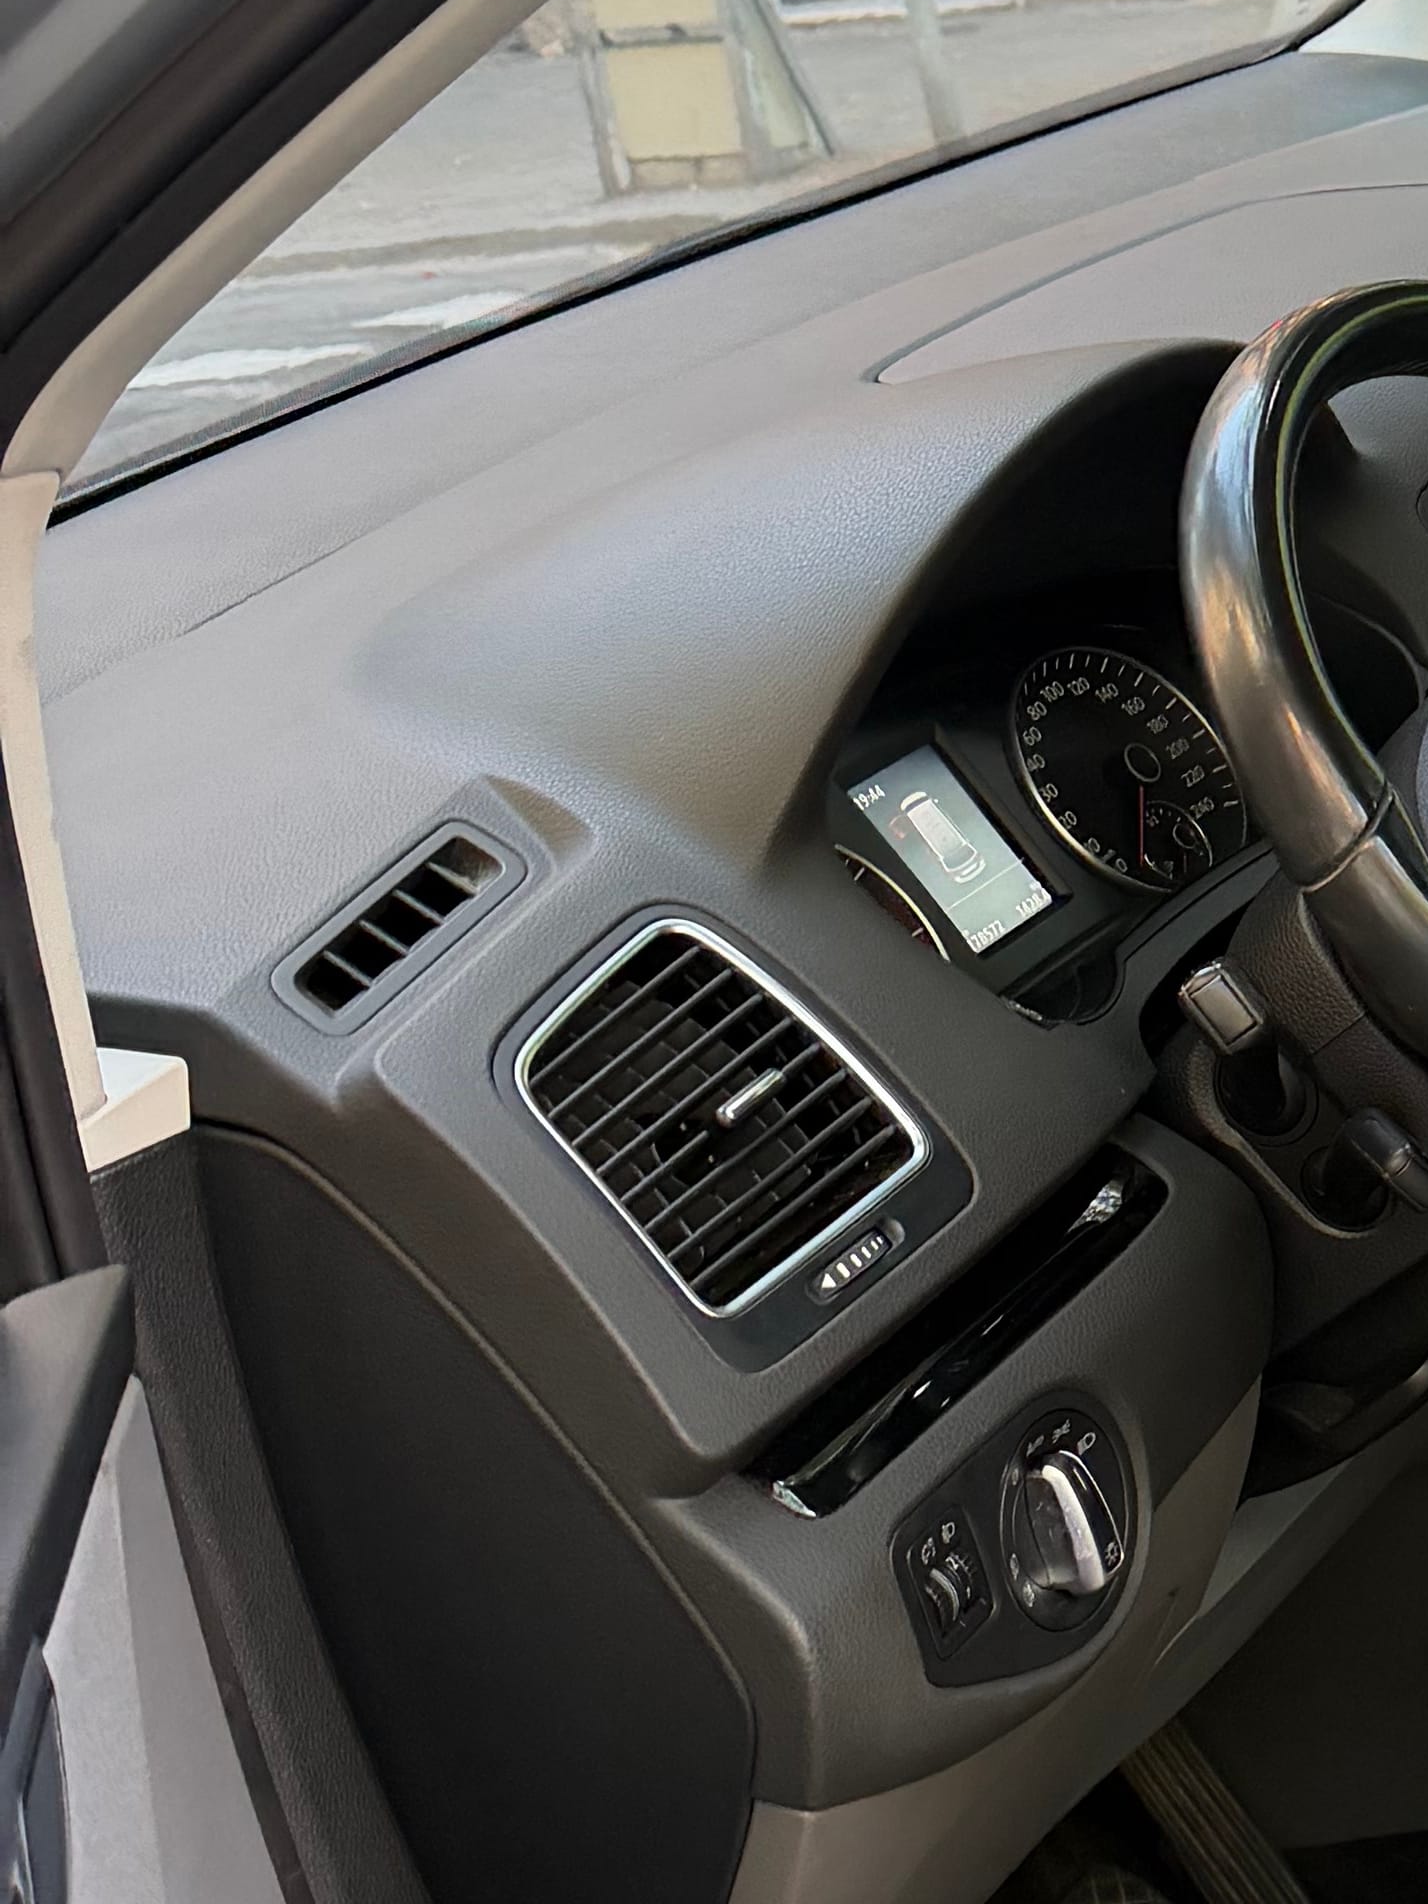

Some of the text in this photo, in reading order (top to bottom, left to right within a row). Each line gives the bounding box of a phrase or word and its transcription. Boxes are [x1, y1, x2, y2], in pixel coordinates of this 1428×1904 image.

[1040, 681, 1064, 703] 100
[1067, 677, 1090, 697] 120
[1095, 682, 1119, 703] 140
[1026, 701, 1048, 721] 80
[1121, 697, 1146, 716] 160
[1022, 727, 1042, 747] 60
[1026, 754, 1046, 773] 40
[852, 785, 886, 811] 19:44
